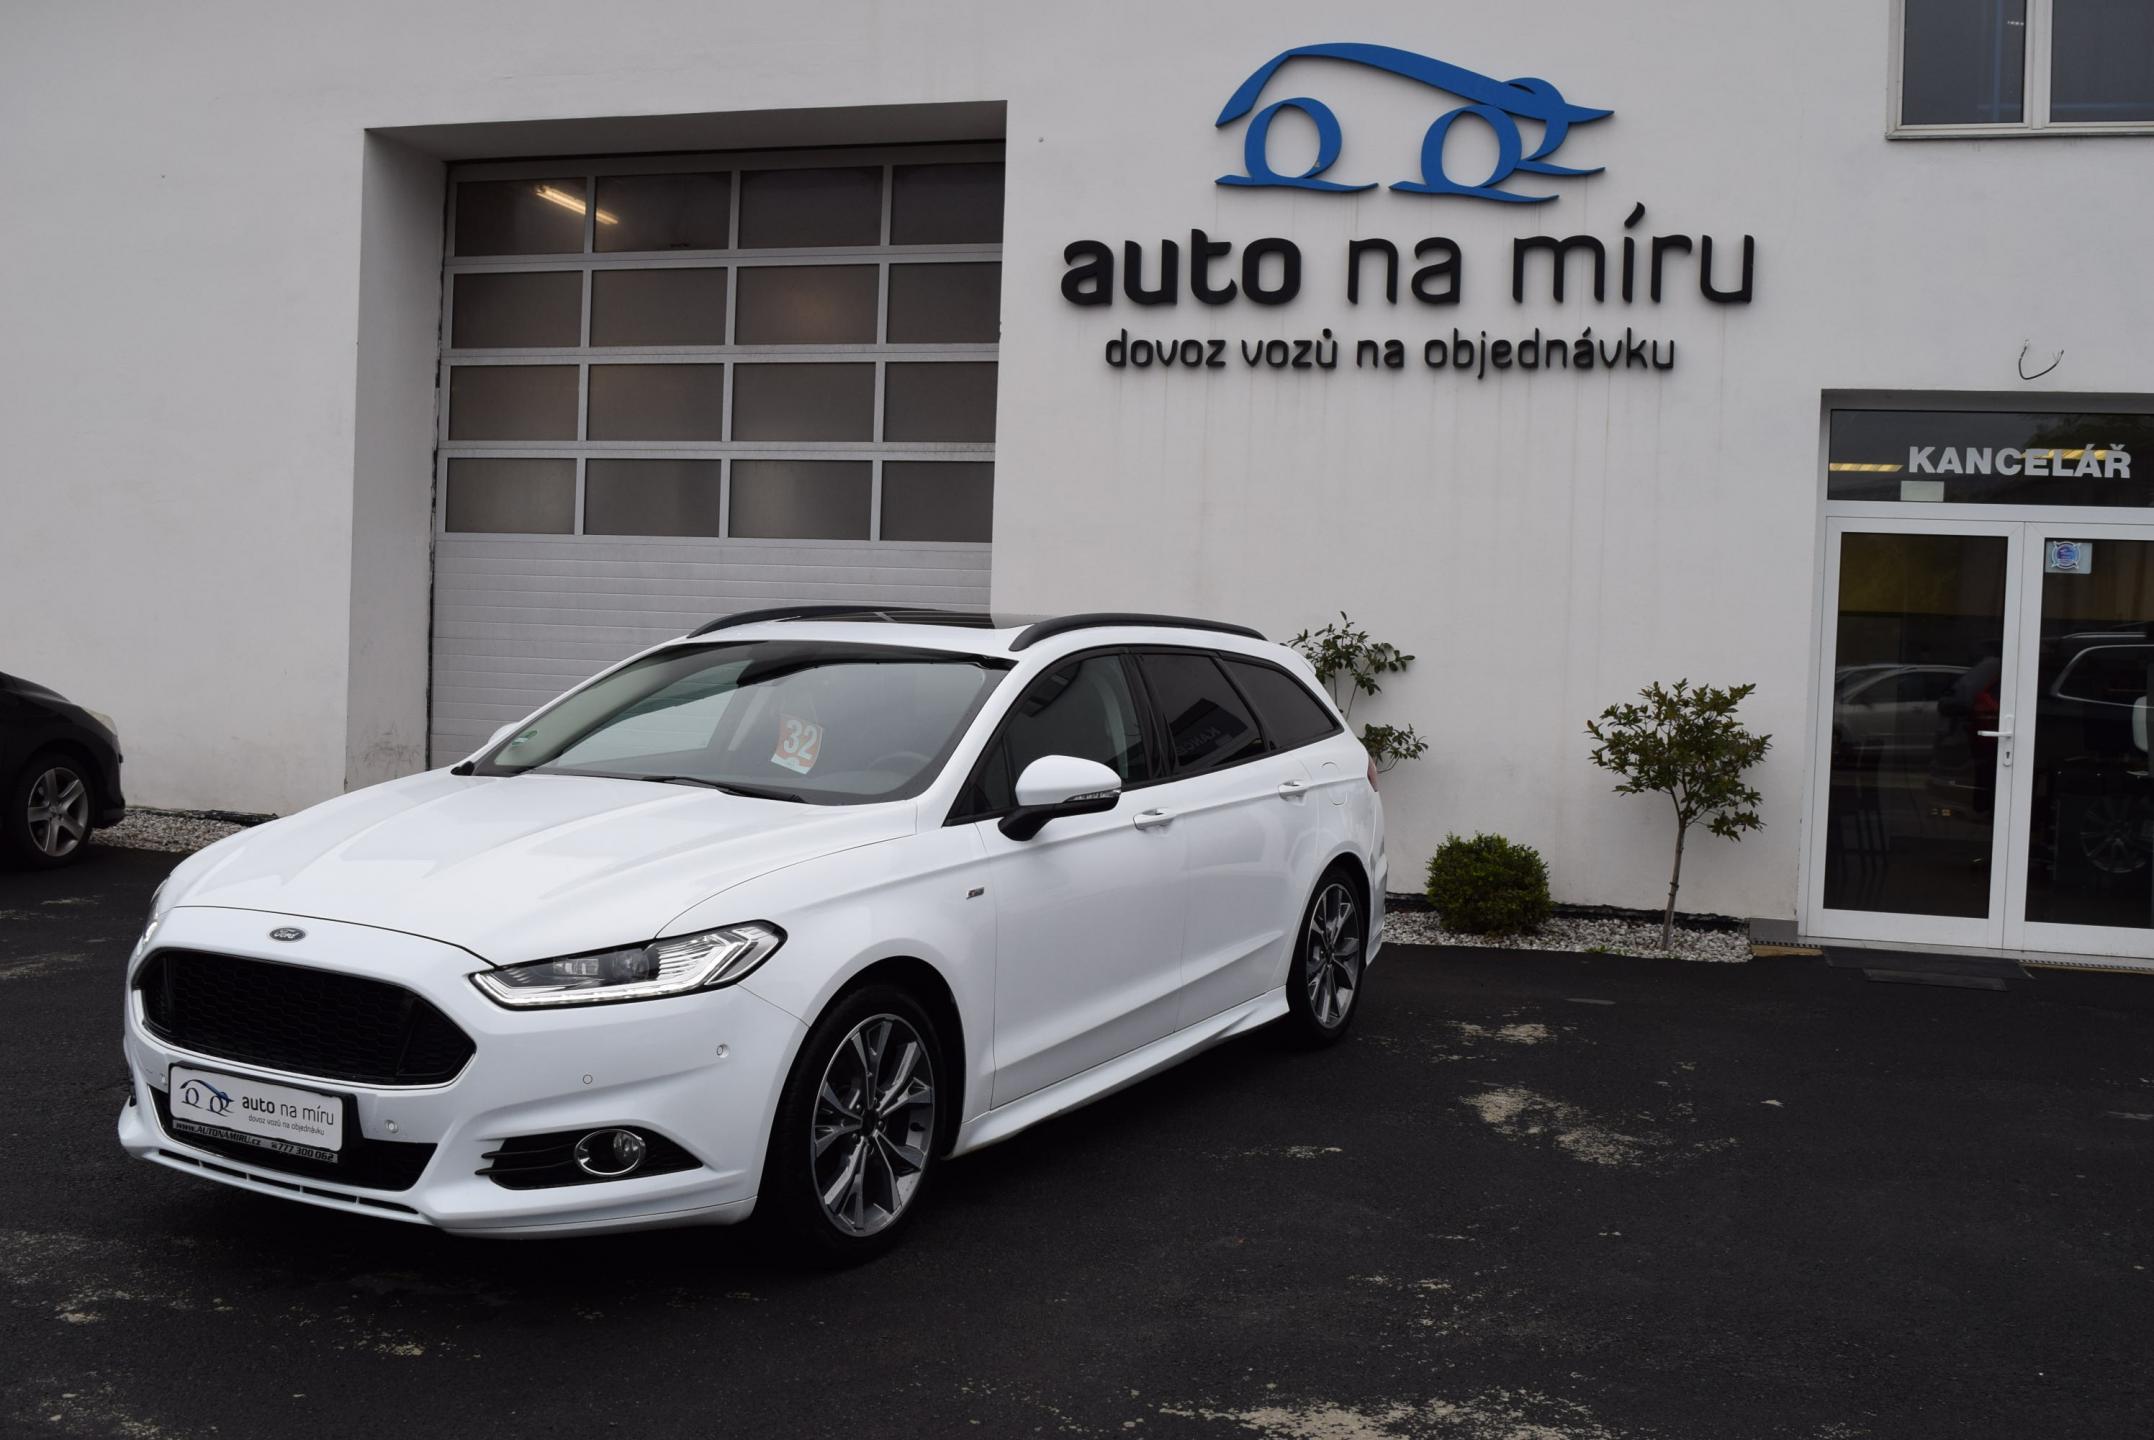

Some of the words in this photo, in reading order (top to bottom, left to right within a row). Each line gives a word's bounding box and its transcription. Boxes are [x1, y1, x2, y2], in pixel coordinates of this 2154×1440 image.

[1061, 229, 1302, 306] auto
[1348, 236, 1462, 306] na
[1512, 201, 1755, 305] míru
[1105, 329, 1226, 368] dovoz
[1241, 328, 1338, 369] vozů
[1356, 339, 1405, 368] na
[1425, 327, 1676, 379] objednávku
[1908, 443, 2132, 479] KANCELÁŘ
[783, 719, 818, 760] 32
[242, 1096, 275, 1114] auto
[280, 1103, 297, 1118] na
[302, 1105, 334, 1125] míru
[248, 1115, 265, 1123] dovoz
[291, 1122, 325, 1136] objednávku
[295, 1147, 313, 1157] 300
